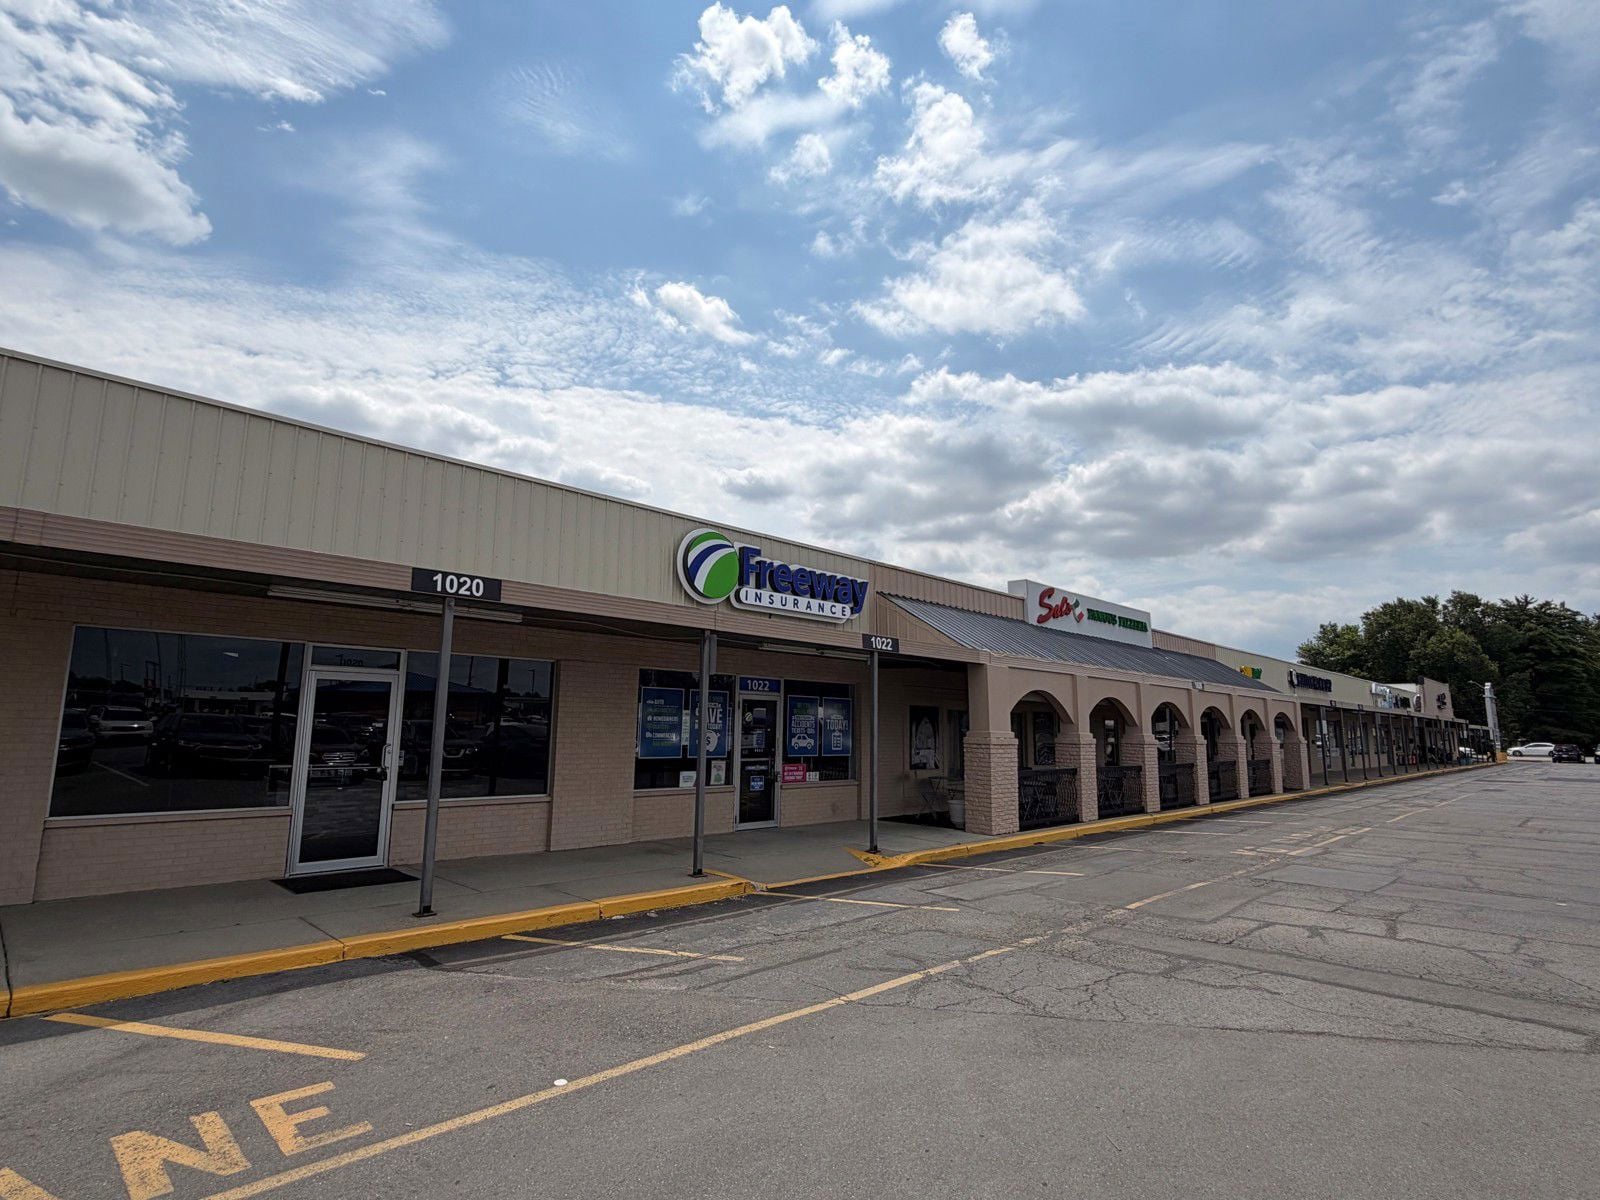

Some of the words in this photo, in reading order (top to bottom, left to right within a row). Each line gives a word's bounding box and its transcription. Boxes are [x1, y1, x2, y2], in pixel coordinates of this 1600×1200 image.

[432, 573, 484, 598] 1020
[739, 546, 869, 614] Freeway
[745, 590, 847, 617] INSURANCE
[871, 636, 893, 651] 1022
[747, 680, 770, 691] 1022
[825, 719, 849, 731] TODAY!
